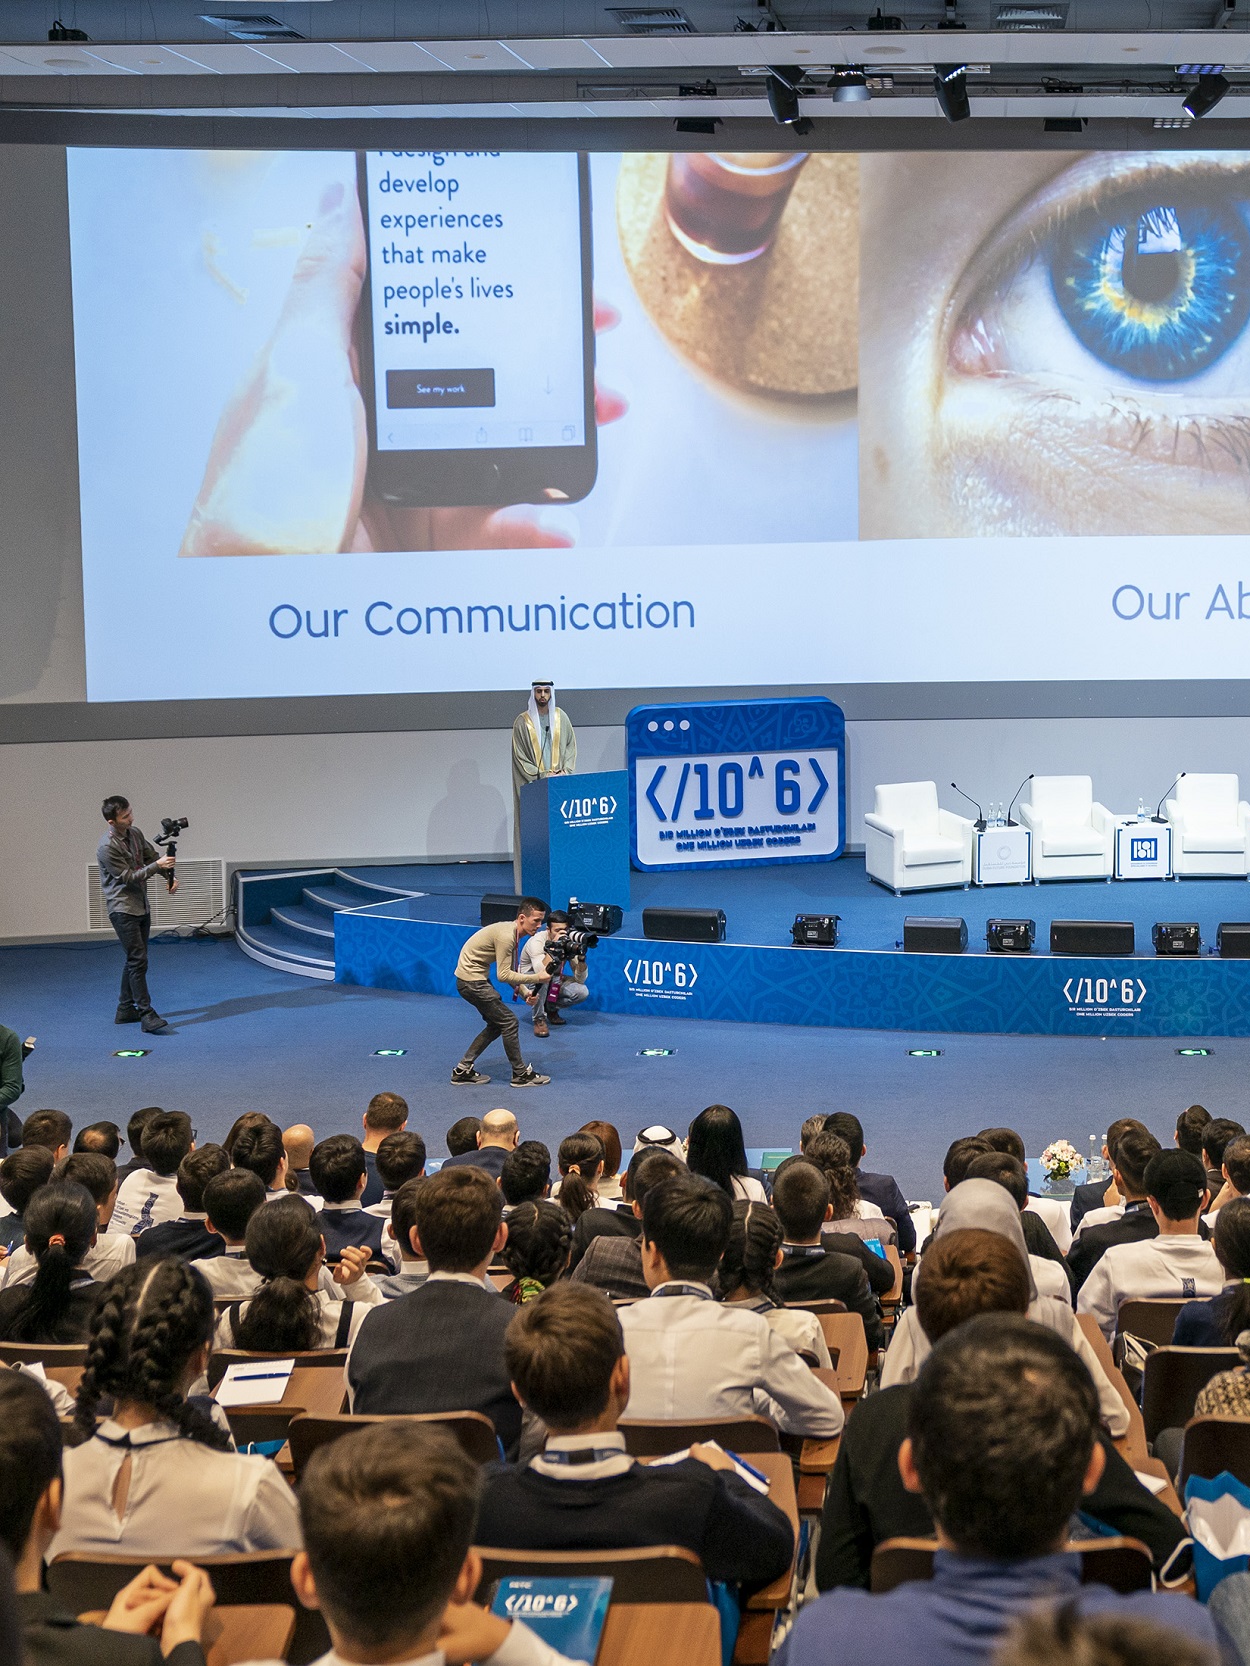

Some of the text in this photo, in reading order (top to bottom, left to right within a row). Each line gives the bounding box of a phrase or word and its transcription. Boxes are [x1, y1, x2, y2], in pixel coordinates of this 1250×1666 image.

[379, 170, 459, 201] develop
[380, 206, 503, 236] experiences
[382, 241, 487, 264] that make
[384, 276, 514, 307] people's lives
[384, 312, 460, 343] simple.
[416, 384, 465, 396] See my work
[269, 592, 695, 639] Our Communication
[1112, 584, 1190, 620] Our
[676, 828, 712, 839] MILLION
[676, 841, 695, 851] ONE
[697, 839, 732, 850] MILLION
